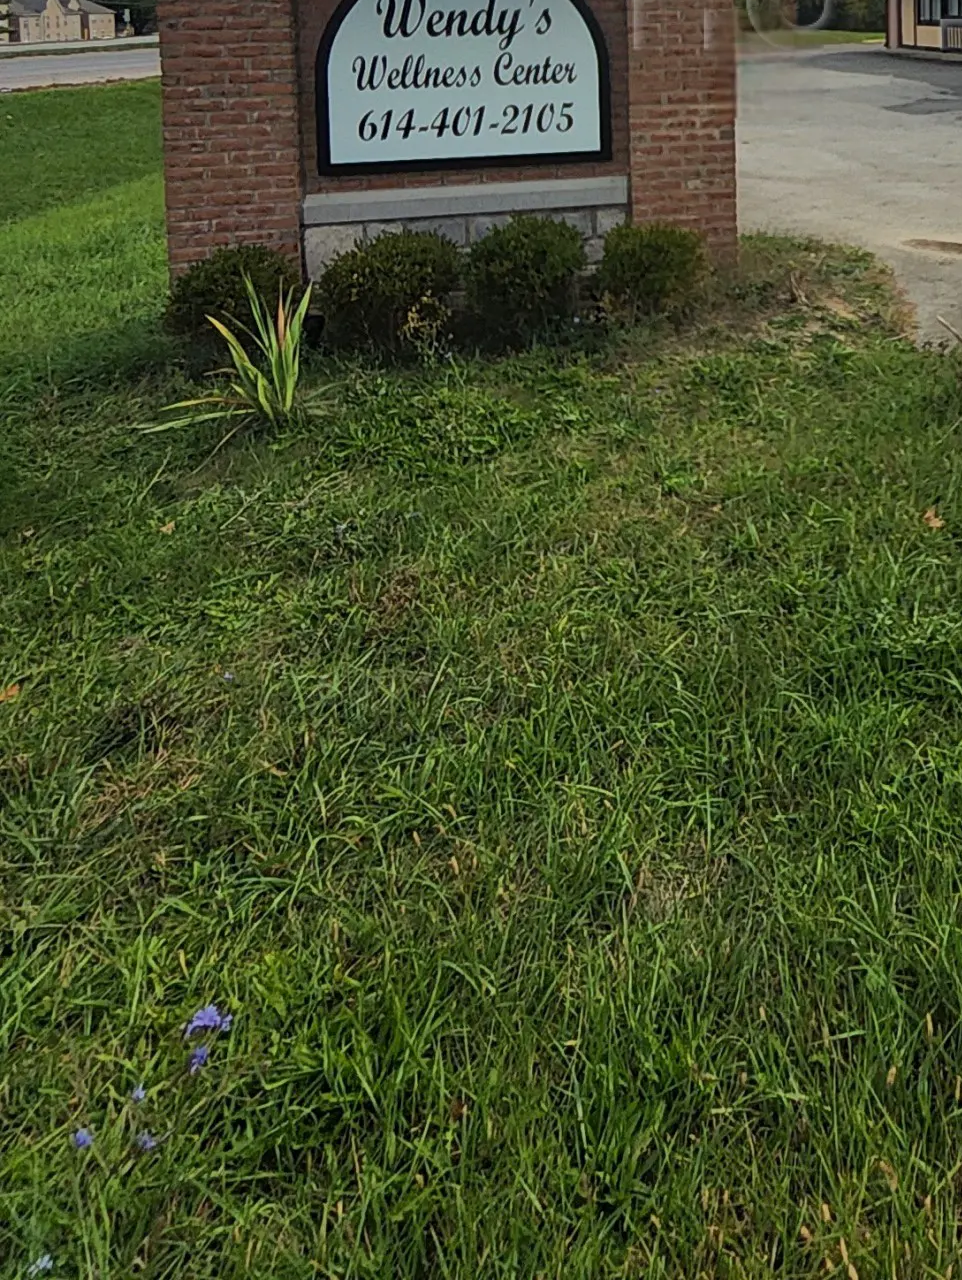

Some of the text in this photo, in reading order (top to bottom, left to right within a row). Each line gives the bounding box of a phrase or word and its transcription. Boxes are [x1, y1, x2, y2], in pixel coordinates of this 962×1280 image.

[351, 51, 578, 92] Wellness Center
[357, 101, 575, 142] 614-401-2105
